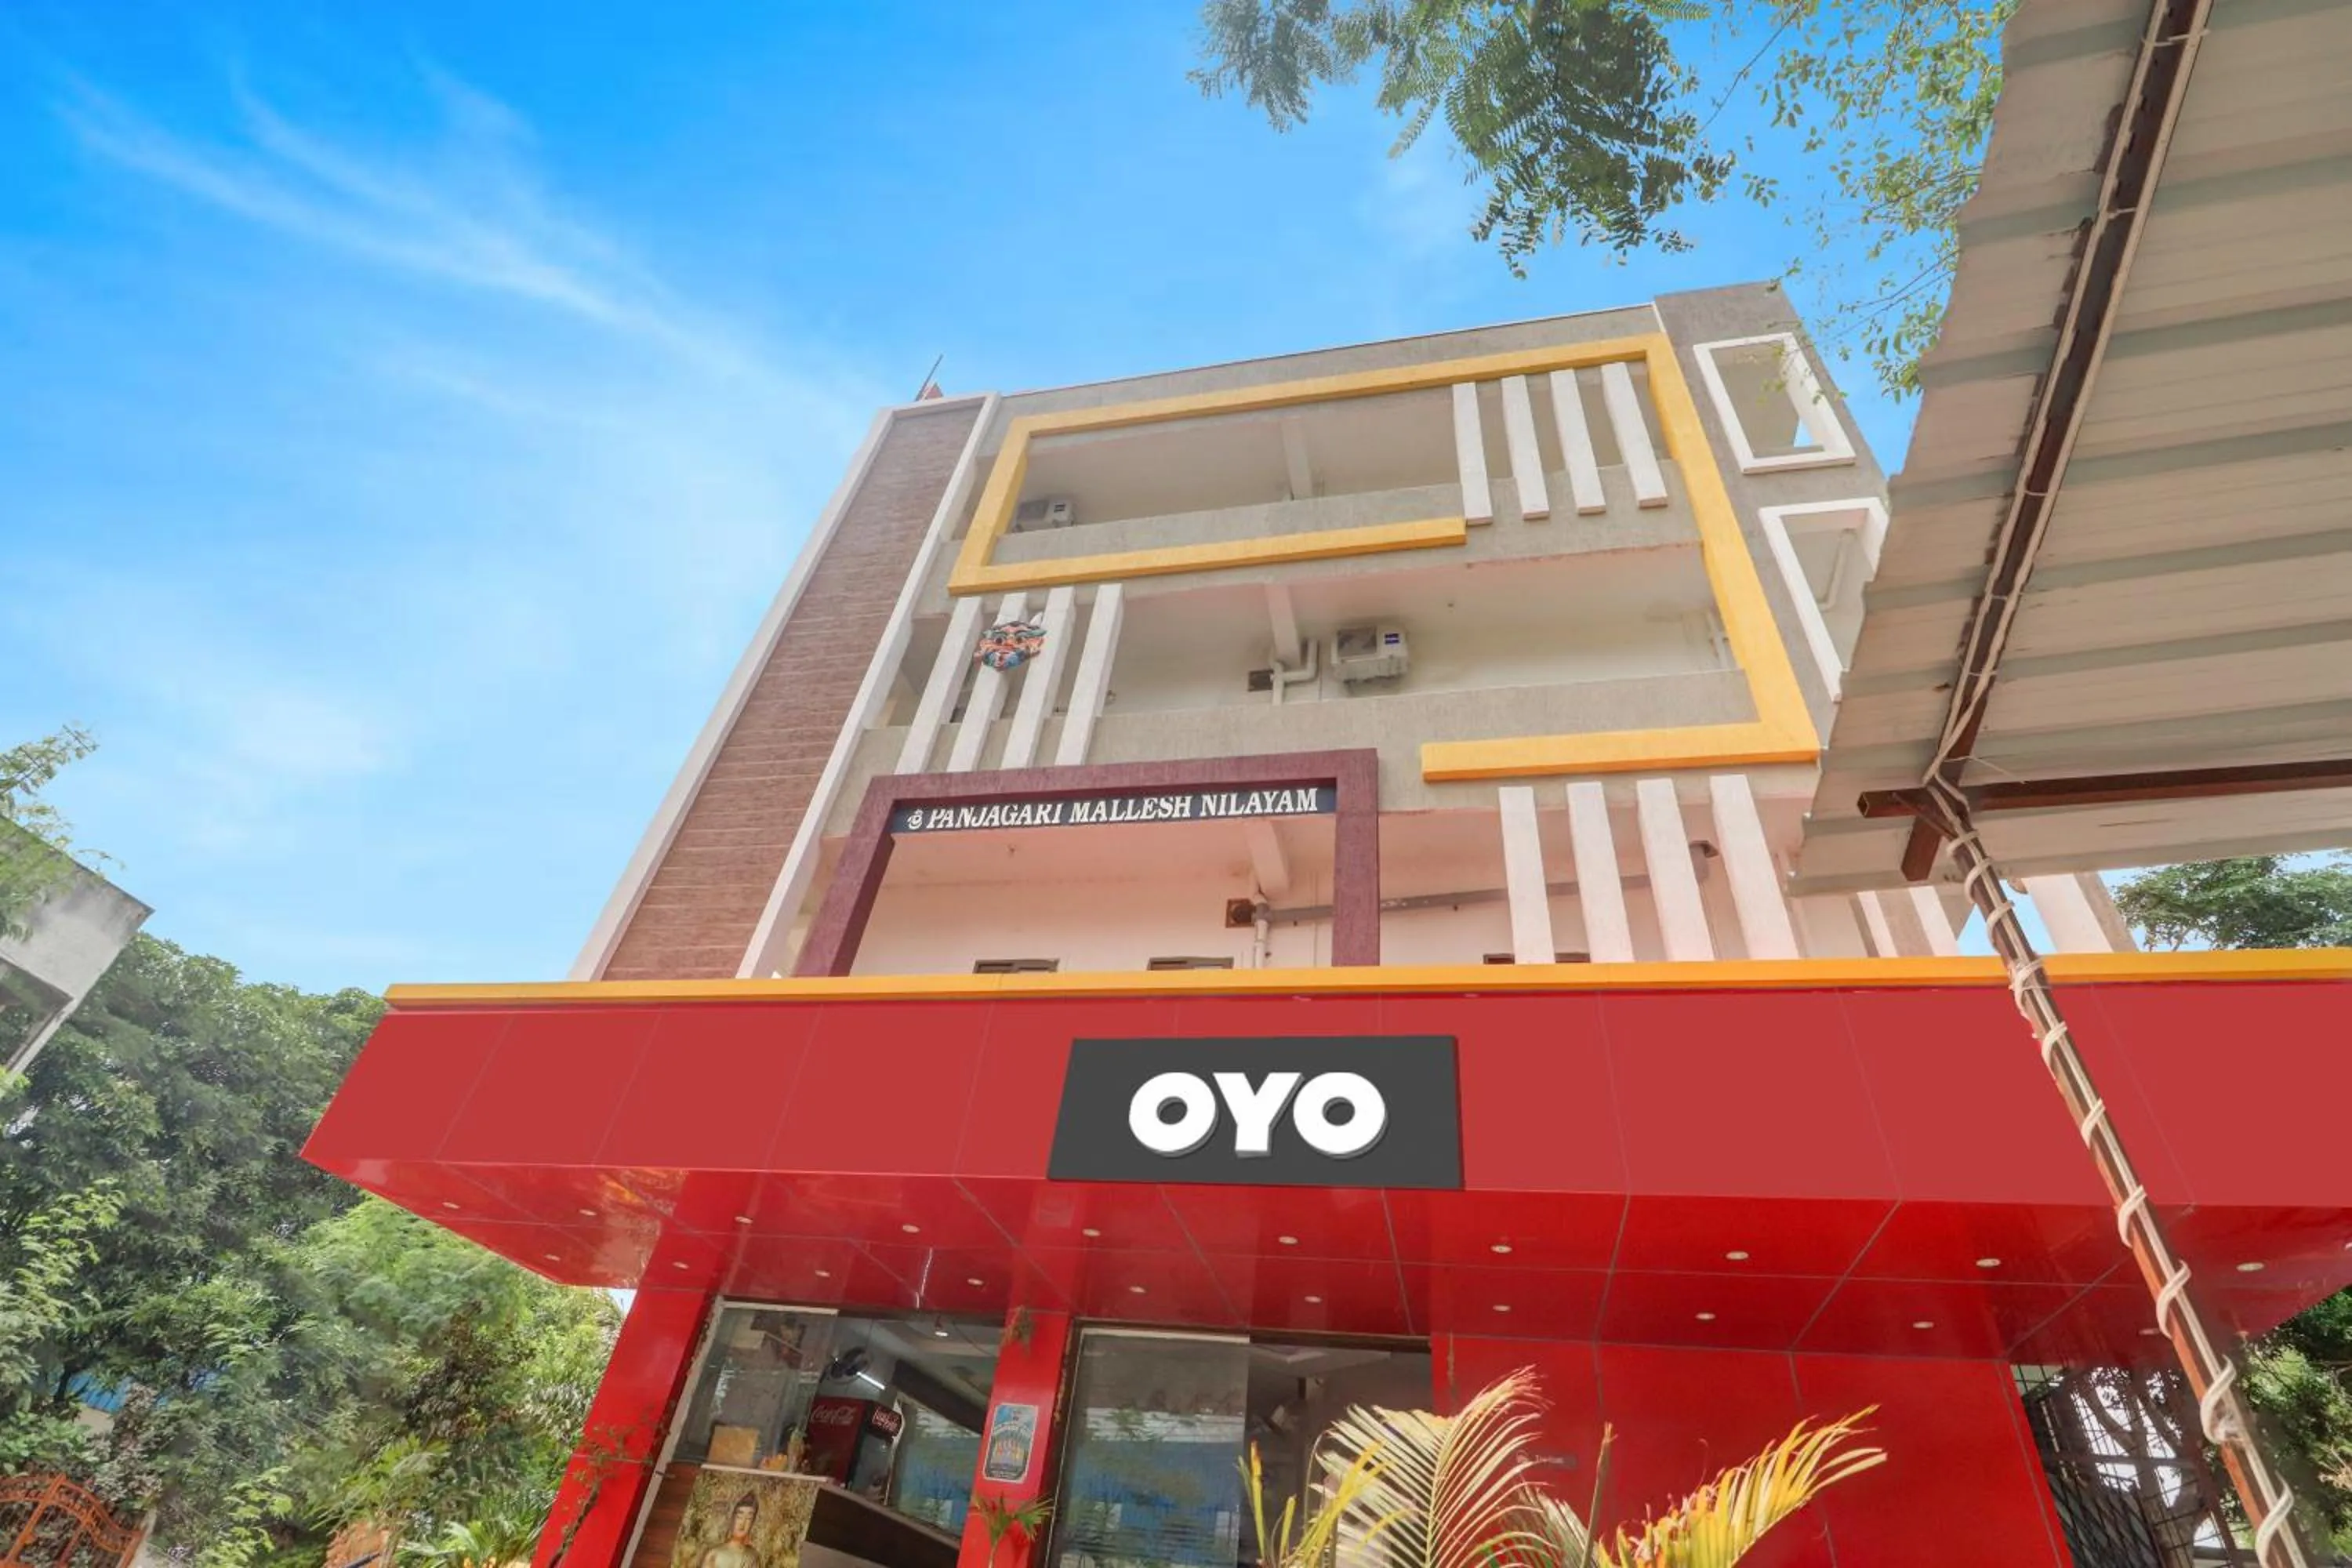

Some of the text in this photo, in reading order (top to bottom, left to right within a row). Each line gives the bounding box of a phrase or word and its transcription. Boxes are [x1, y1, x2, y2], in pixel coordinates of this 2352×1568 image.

[926, 788, 1318, 829] PANJAGARI MALLESH NILAYAM
[1129, 1072, 1388, 1157] OYO
